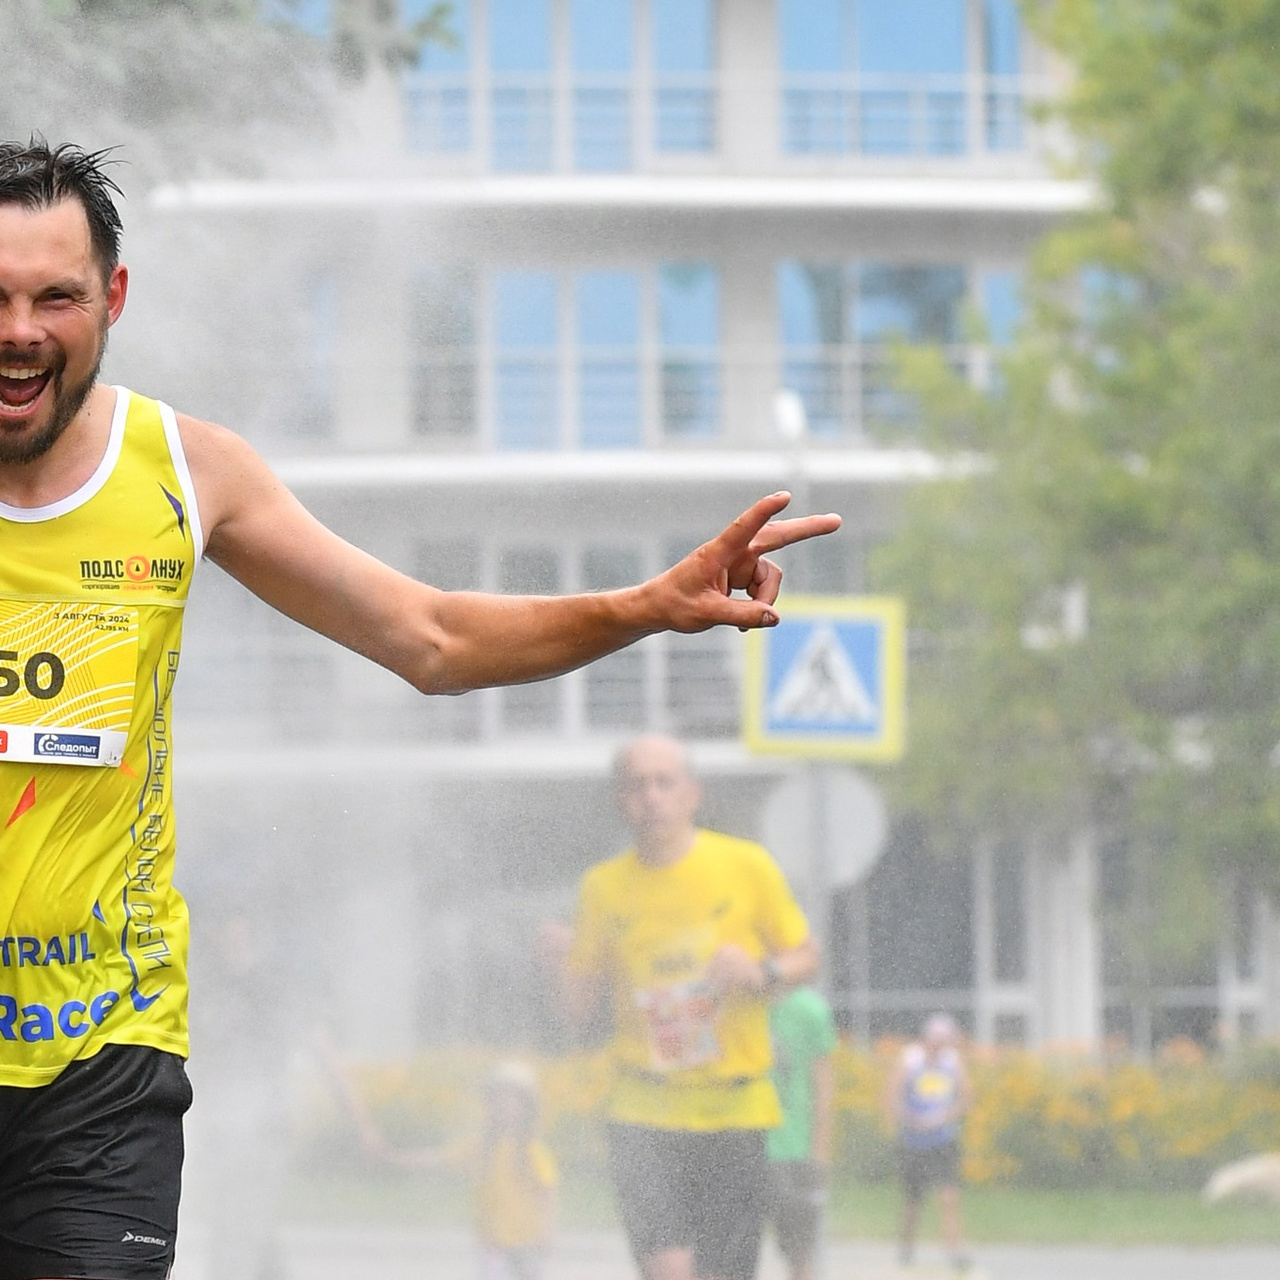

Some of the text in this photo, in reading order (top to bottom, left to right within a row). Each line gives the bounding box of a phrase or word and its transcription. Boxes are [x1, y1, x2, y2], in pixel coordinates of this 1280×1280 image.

[61, 613, 107, 622] АВГУСТА
[108, 615, 130, 623] 2024
[45, 741, 97, 753] Следопыт
